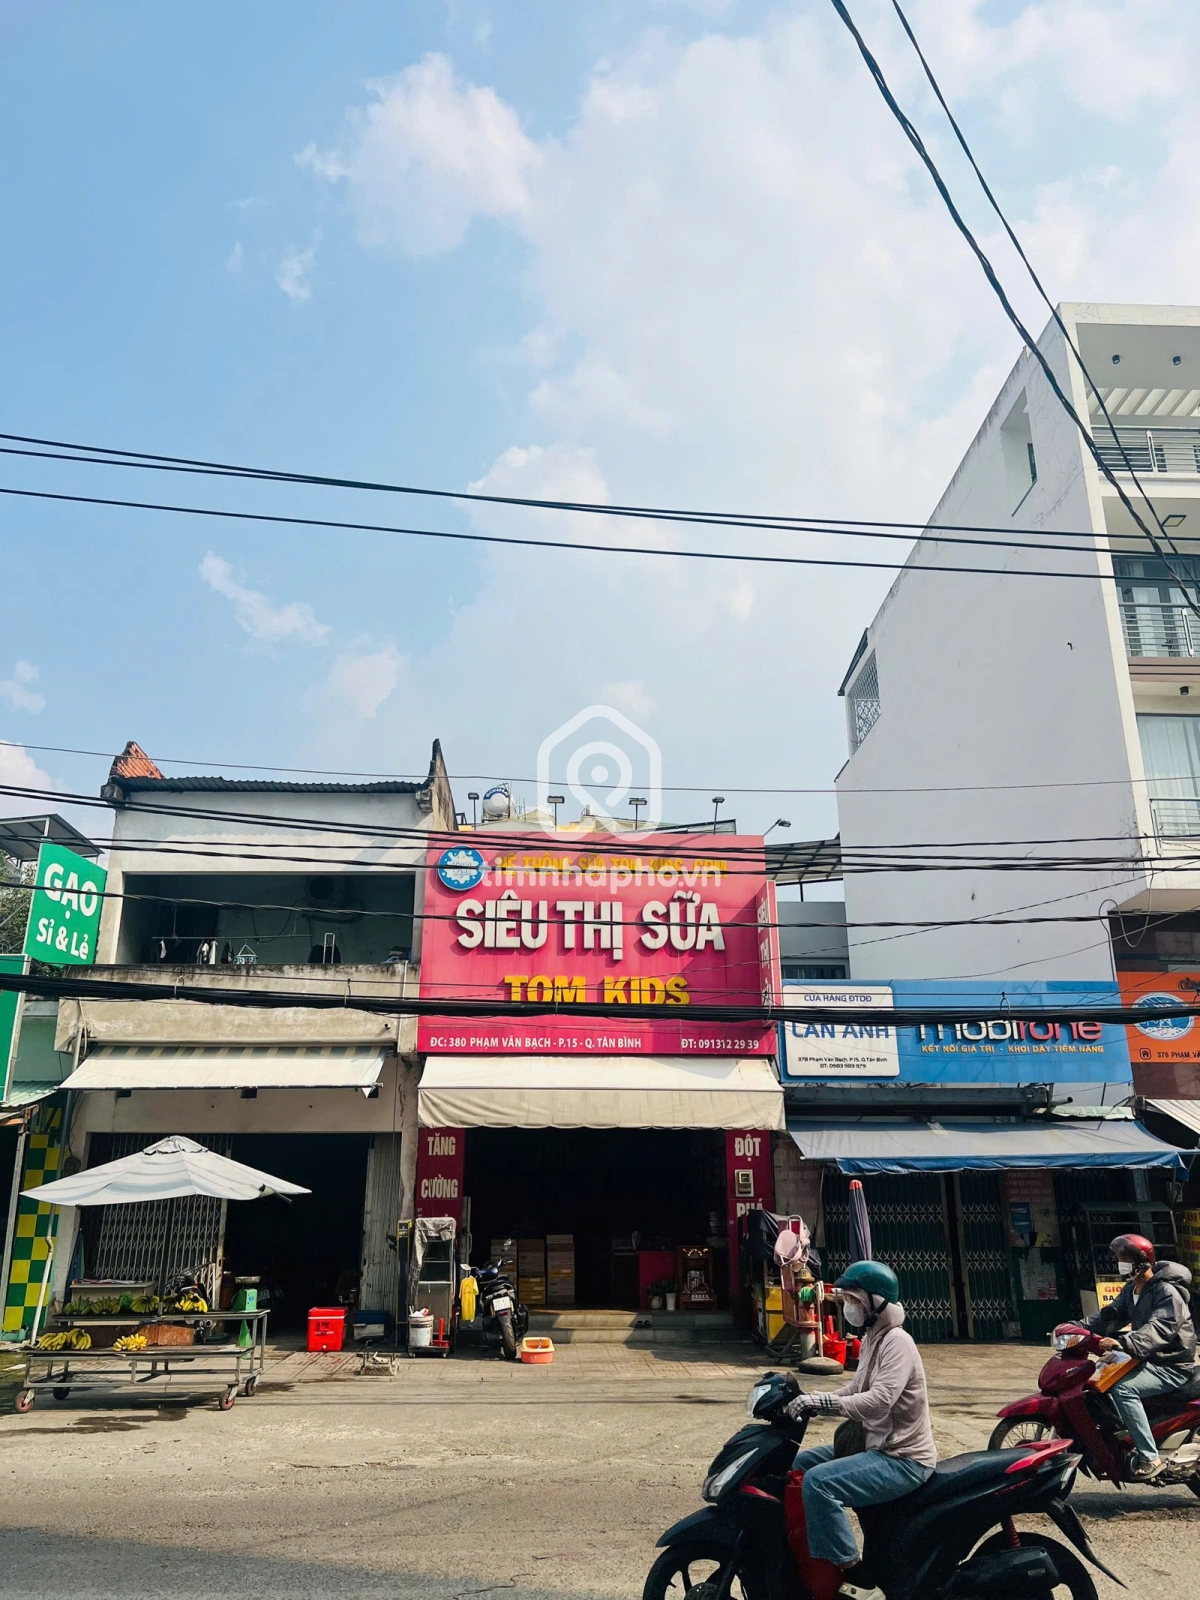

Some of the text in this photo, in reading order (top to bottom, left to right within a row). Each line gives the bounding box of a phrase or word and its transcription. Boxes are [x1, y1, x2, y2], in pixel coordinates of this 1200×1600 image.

[44, 863, 98, 920] GẠO
[456, 888, 726, 961] SIÊU THỊ SỮA
[36, 917, 89, 960] Sỉ & Lẻ
[504, 975, 690, 1006] TOM KIDS
[430, 1037, 447, 1048] ĐC:
[449, 1037, 467, 1048] 380
[470, 1037, 499, 1050] PHẠM
[502, 1035, 521, 1049] VĂN
[525, 1037, 551, 1050] BẠCH
[559, 1037, 578, 1049] P.15
[585, 1038, 595, 1050] Q.
[597, 1035, 617, 1049] TÂN
[618, 1036, 641, 1049] BÌNH
[681, 1038, 697, 1049] ĐT:
[734, 1040, 746, 1049] 29
[747, 1039, 759, 1049] 39
[921, 1043, 940, 1053] KẾT
[942, 1043, 959, 1053] NỐI
[961, 1043, 977, 1053] GIÁ
[979, 1044, 995, 1054] TRỊ
[427, 1132, 456, 1156] TĂNG
[735, 1133, 761, 1162] ĐỘT
[421, 1173, 459, 1199] CƯỜNG
